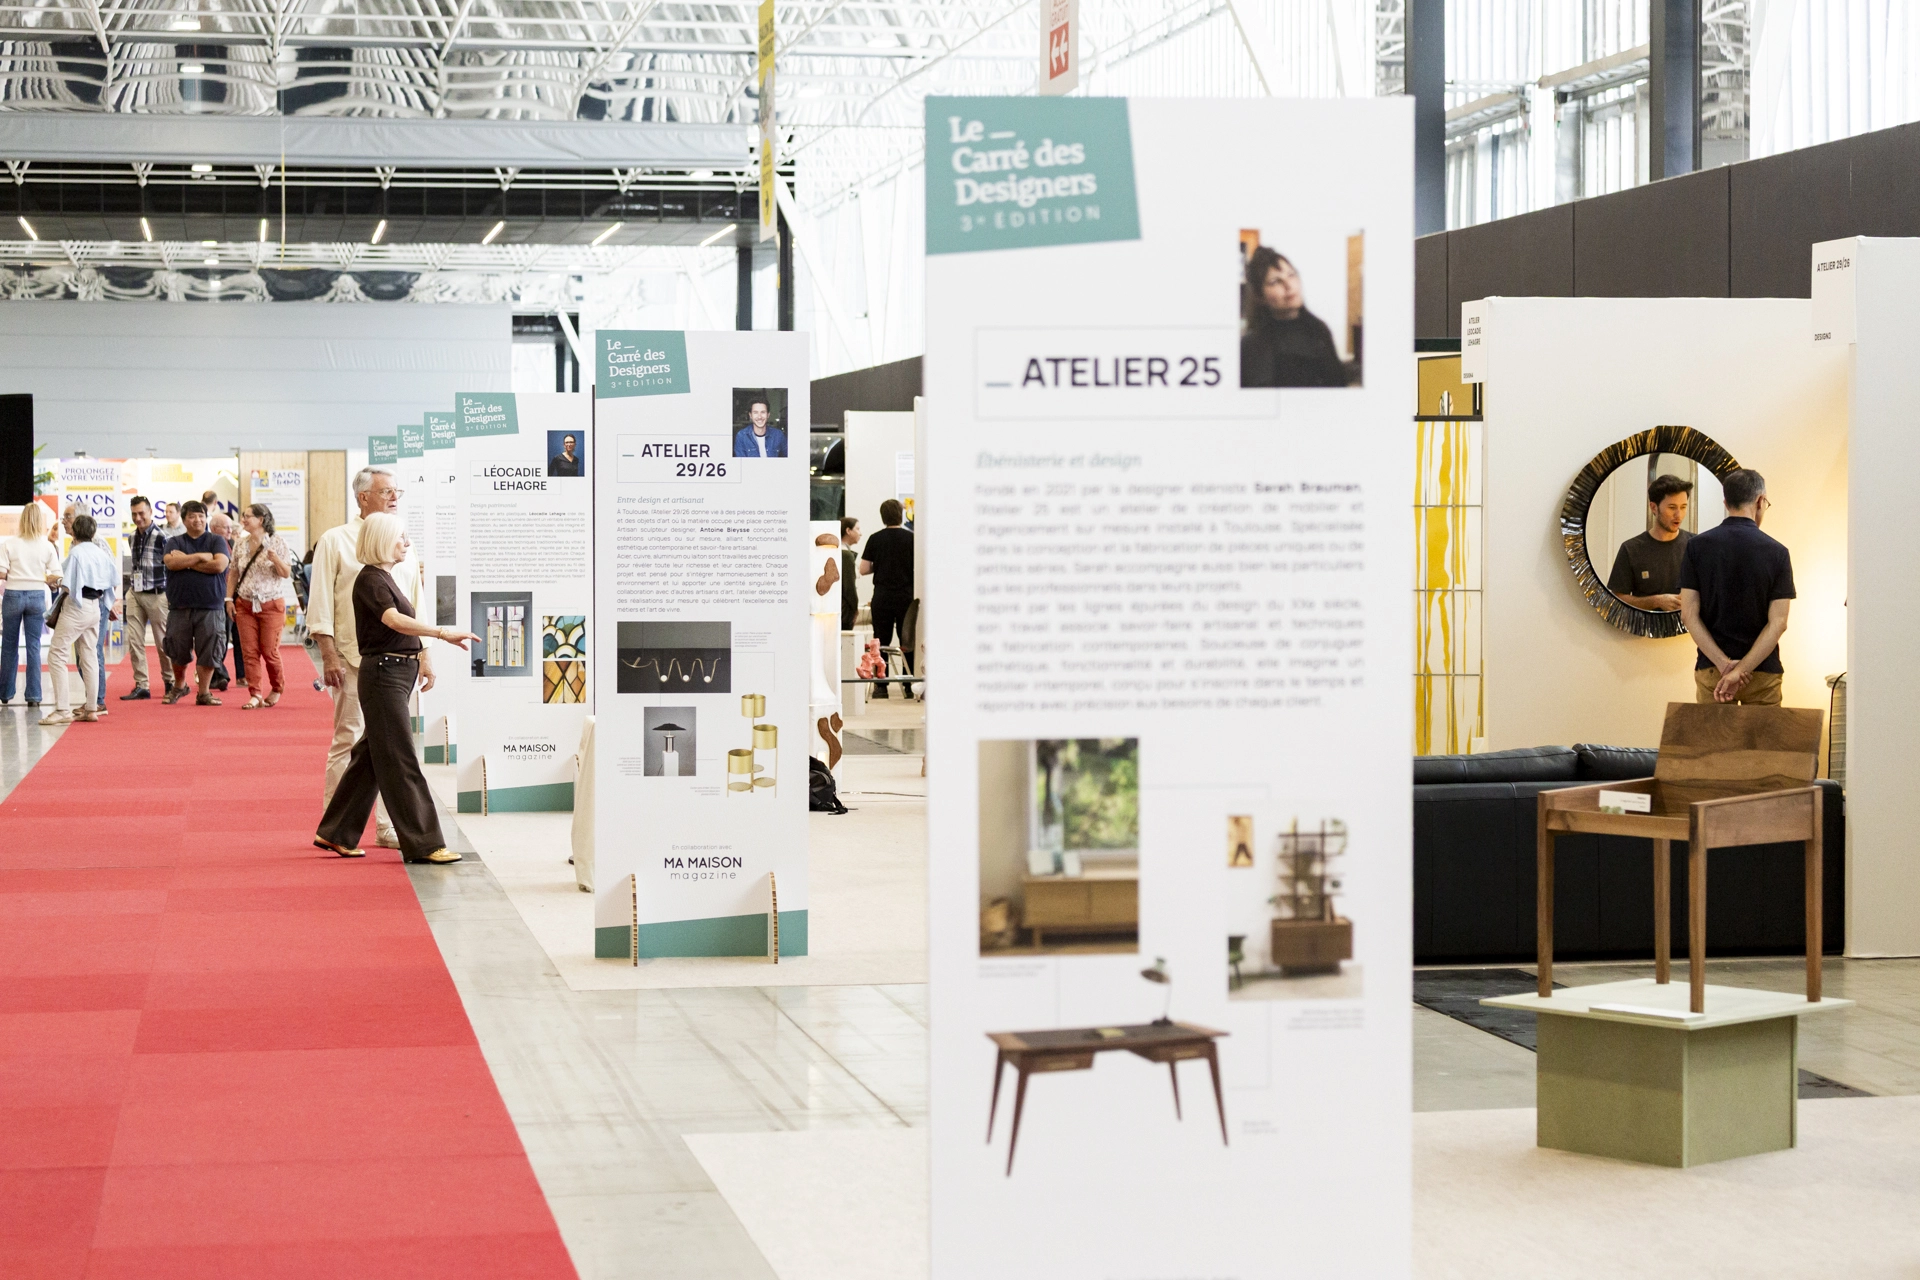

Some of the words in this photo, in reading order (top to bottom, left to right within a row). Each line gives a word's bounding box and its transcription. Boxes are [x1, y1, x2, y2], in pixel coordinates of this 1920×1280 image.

[948, 116, 984, 144] Le
[951, 142, 1029, 174] Carré
[1034, 138, 1085, 168] des
[954, 172, 1098, 208] Designers
[995, 203, 1101, 230] ÉDITION
[1817, 260, 1836, 272] ATELIER
[1836, 257, 1850, 270] 29/26
[606, 339, 621, 350] Le
[608, 350, 641, 363] Carré
[643, 349, 665, 361] des
[609, 363, 671, 378] Designers
[1022, 356, 1168, 388] ATELIER
[1178, 356, 1222, 388] 25
[626, 376, 673, 388] ÉDITION
[464, 405, 486, 415] Carré
[488, 404, 502, 413] des
[464, 413, 506, 424] Designers
[430, 422, 449, 431] Carré
[431, 430, 455, 439] Design
[642, 444, 710, 458] ATELIER
[1069, 453, 1084, 468] et
[1089, 452, 1141, 471] design
[484, 464, 542, 477] LÉOCADIE
[676, 463, 726, 477] 29/26
[493, 481, 547, 491] LEHAGRE
[1252, 483, 1294, 495] Sarah
[638, 496, 661, 505] design
[503, 744, 517, 753] MA
[519, 744, 556, 752] MAISON
[508, 753, 552, 761] magazine
[664, 857, 684, 868] MA
[688, 856, 742, 868] MAISON
[670, 870, 737, 882] magazine
